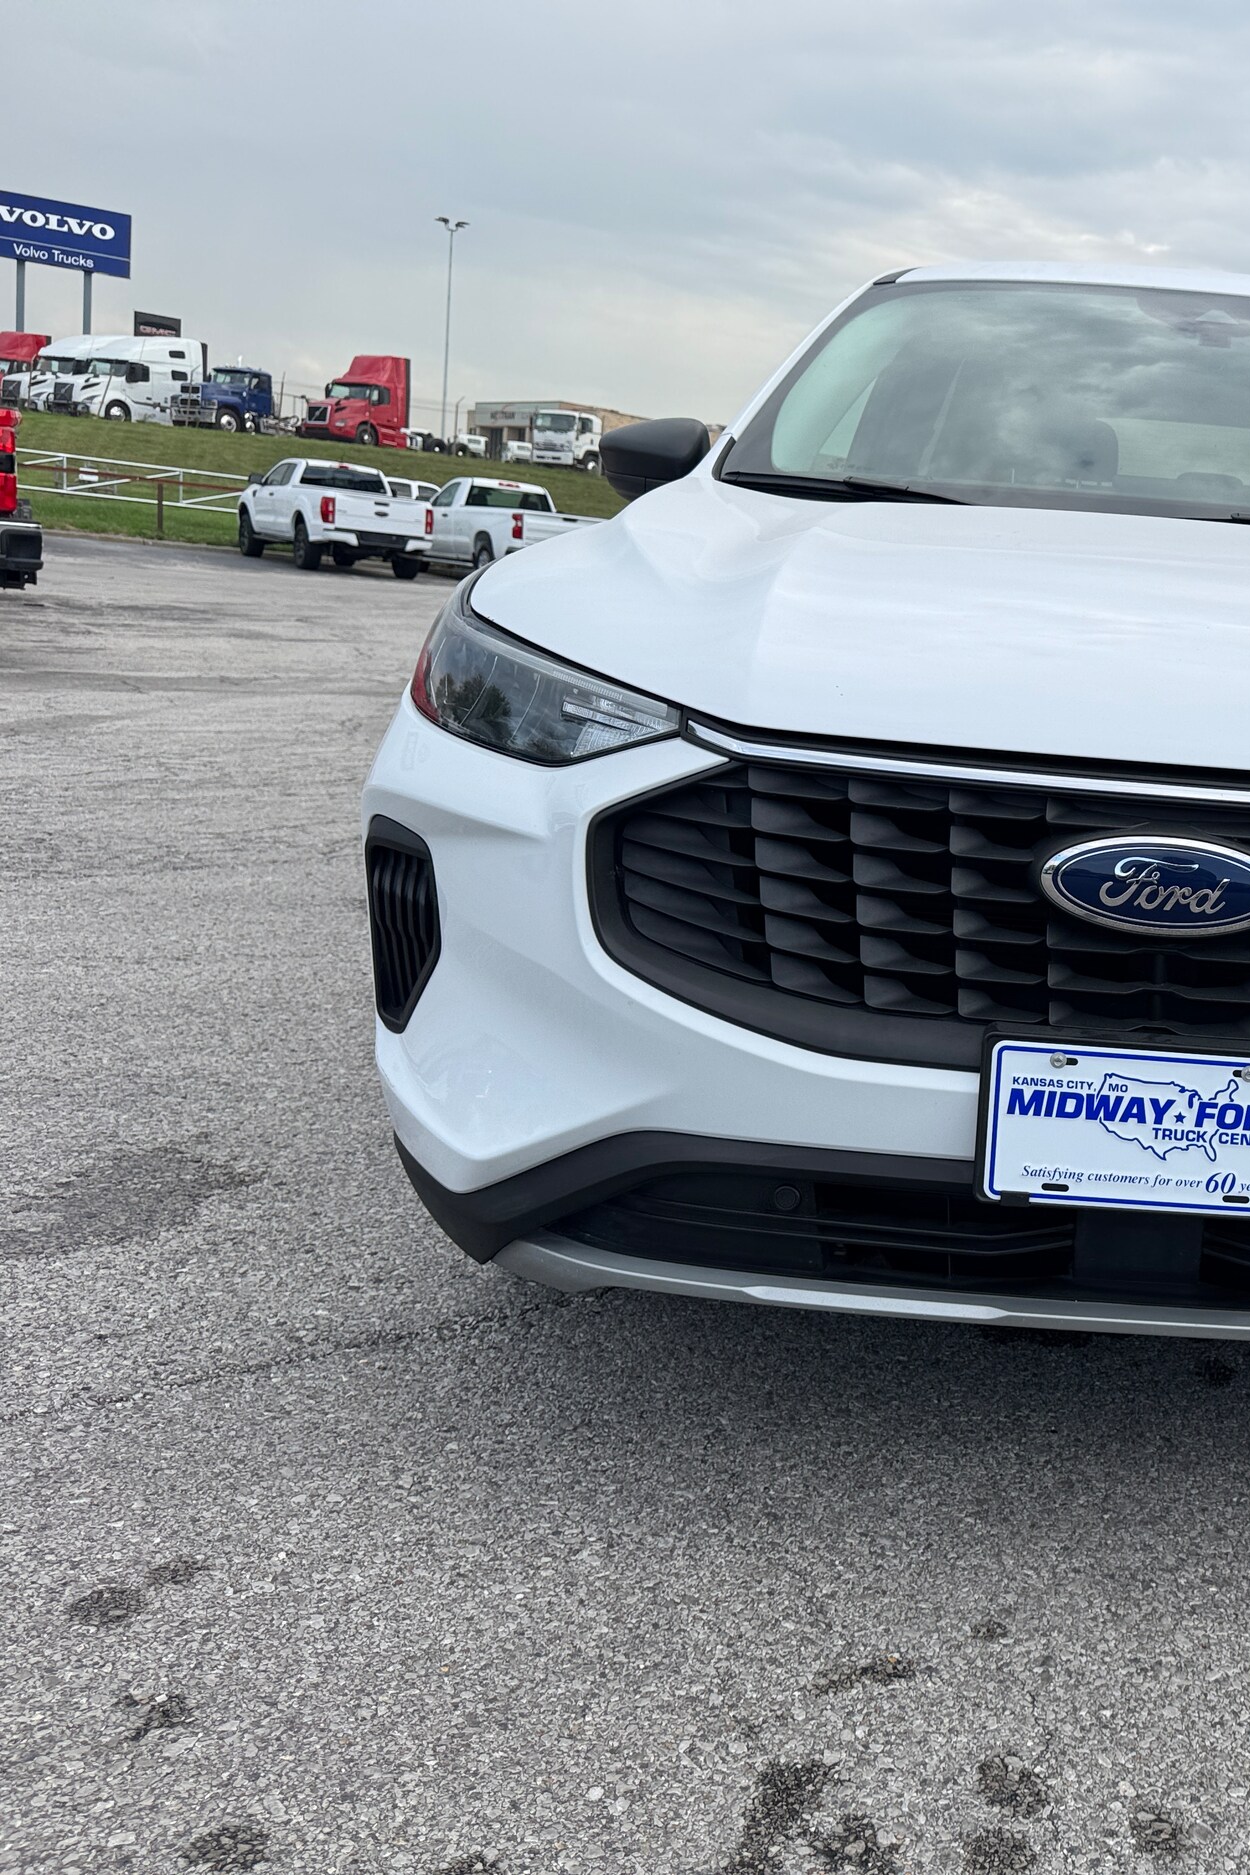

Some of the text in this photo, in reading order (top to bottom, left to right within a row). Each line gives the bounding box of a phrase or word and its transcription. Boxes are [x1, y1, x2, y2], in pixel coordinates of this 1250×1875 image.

[0, 205, 115, 240] VOLVO
[13, 243, 94, 268] Volvo Trucks
[1099, 856, 1231, 914] Ford
[1012, 1076, 1128, 1093] KANSAS CITY, MO
[1006, 1088, 1176, 1125] MIDWAY
[1152, 1127, 1208, 1143] TRUCK
[1021, 1165, 1084, 1183] Satisfying
[1087, 1172, 1150, 1185] customers
[1151, 1174, 1173, 1188] for
[1175, 1179, 1203, 1189] over
[1205, 1172, 1236, 1194] 60
